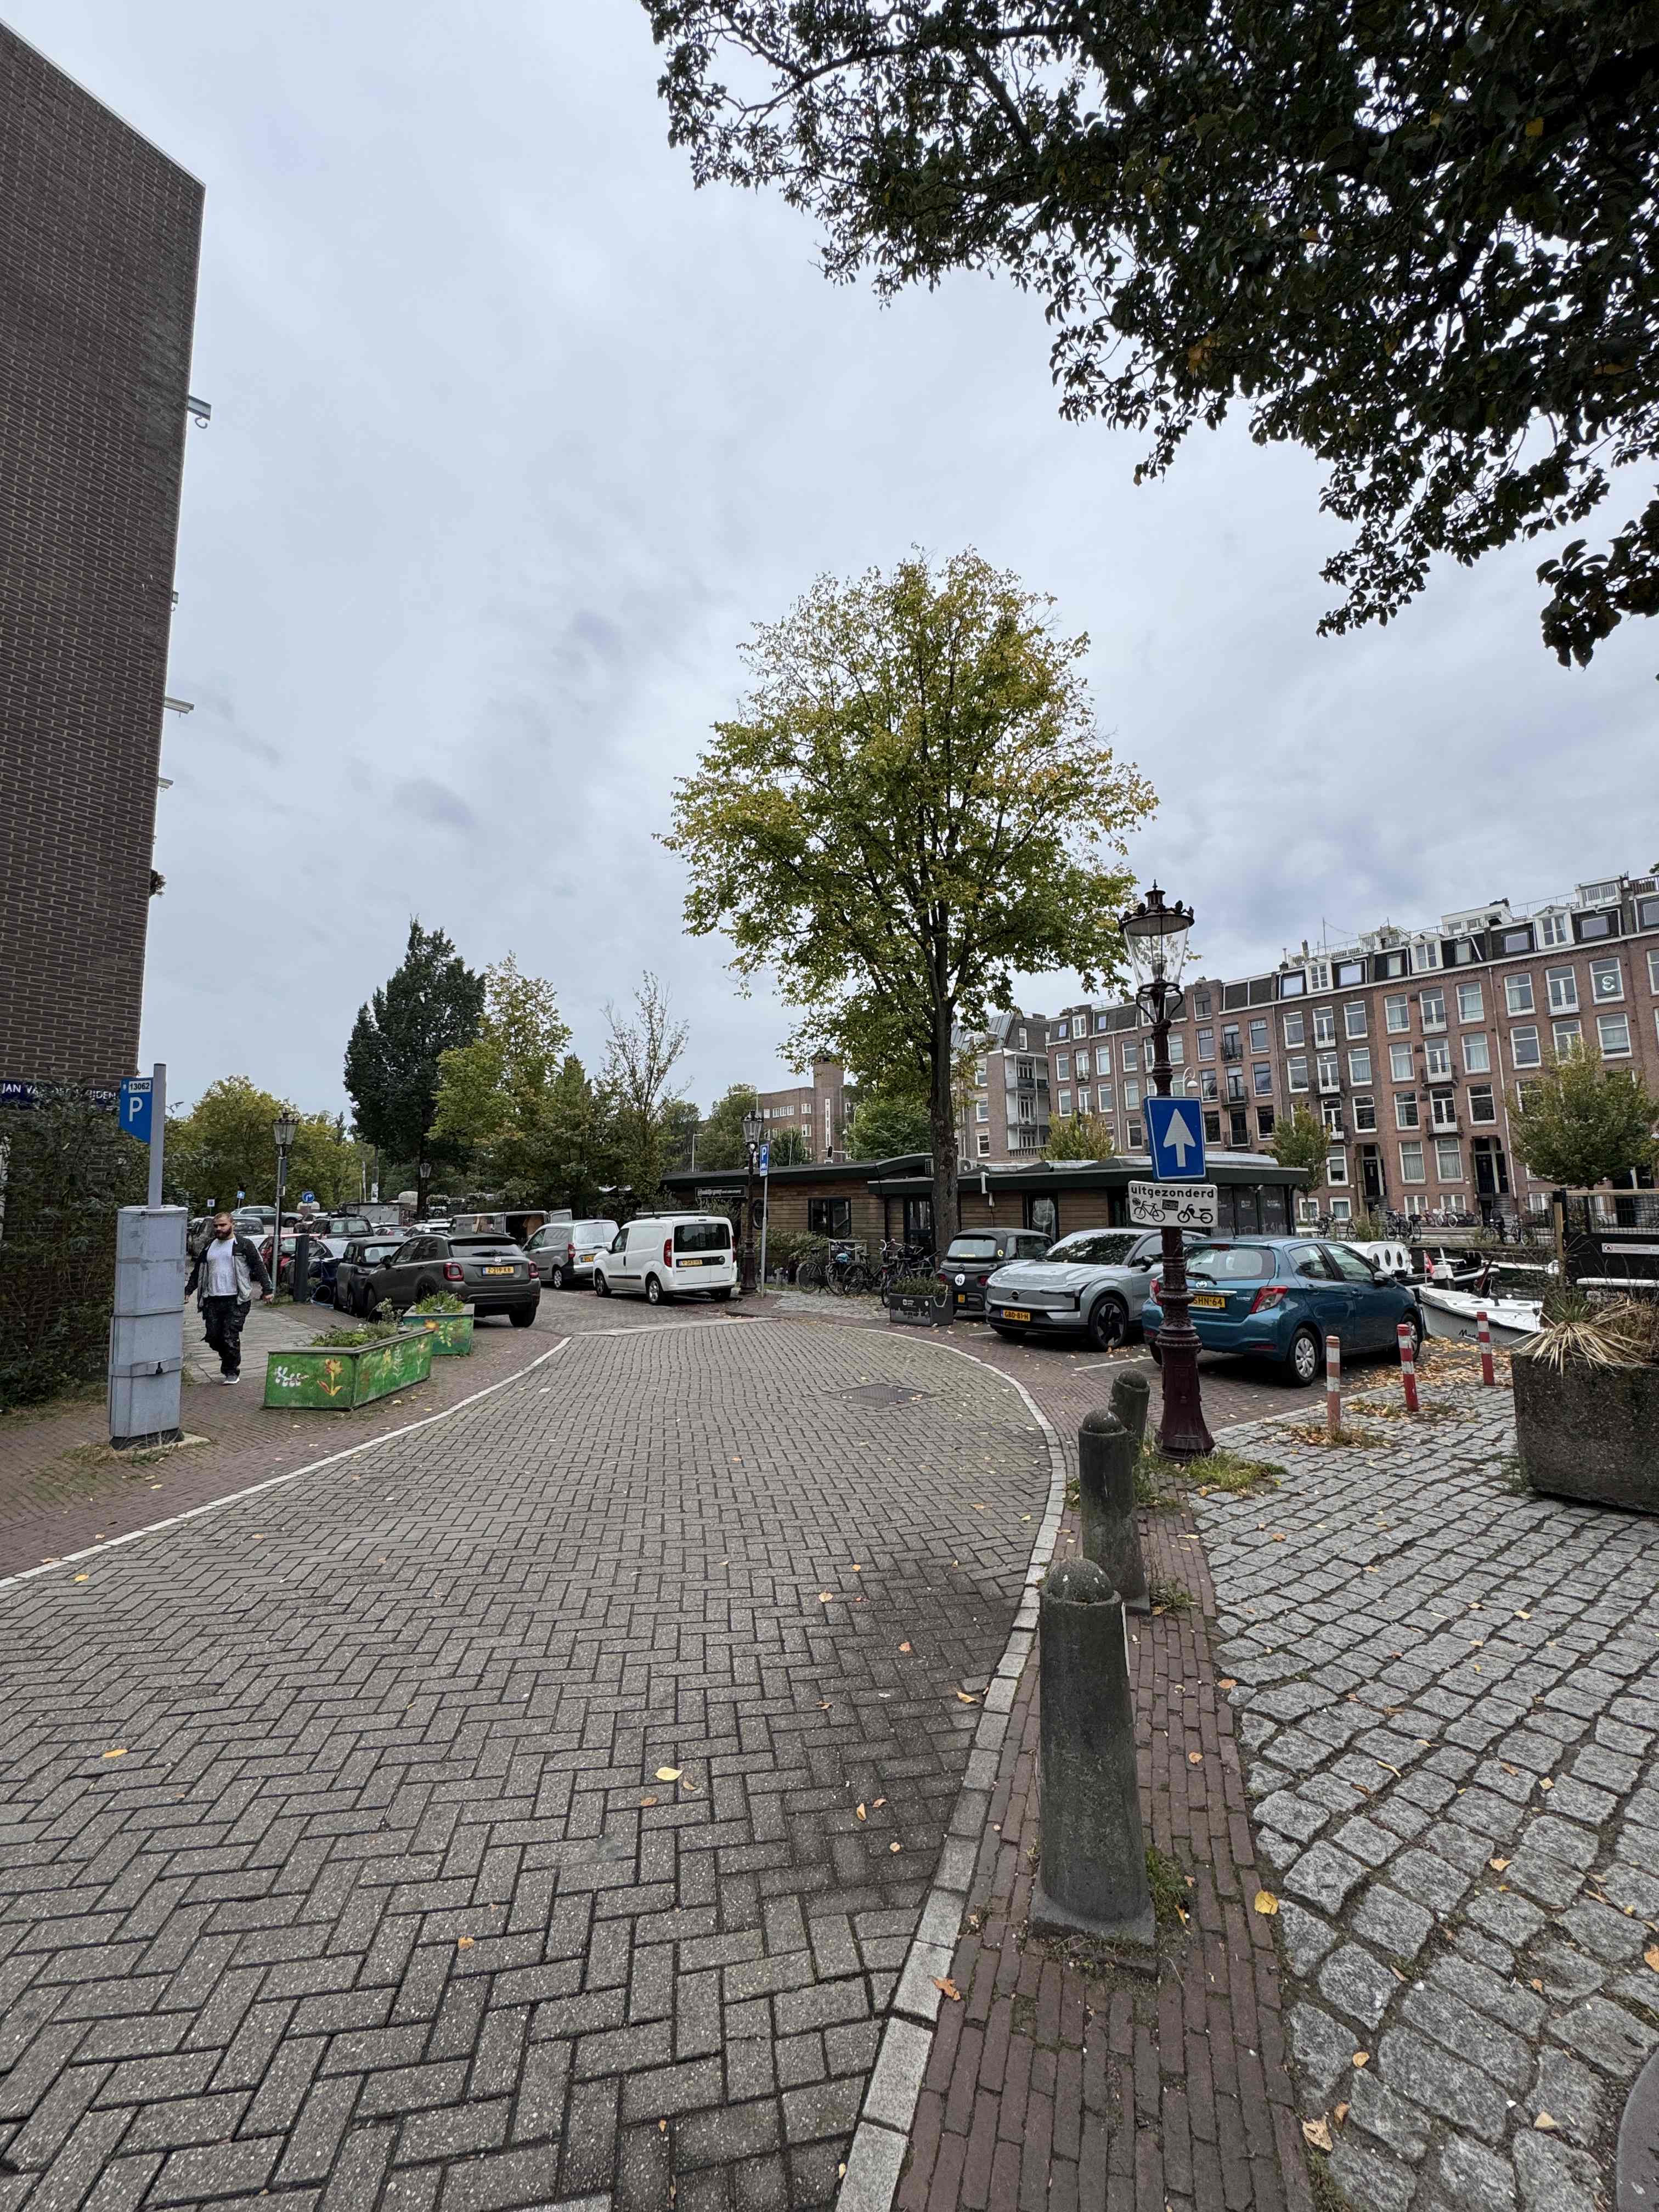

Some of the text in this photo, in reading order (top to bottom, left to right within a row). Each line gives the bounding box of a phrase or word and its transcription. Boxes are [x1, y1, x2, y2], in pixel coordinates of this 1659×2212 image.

[2, 1083, 21, 1093] JAN
[129, 1097, 143, 1121] P
[1131, 1186, 1214, 1198] uitgezonderd
[1193, 1296, 1223, 1306] SHN-64
